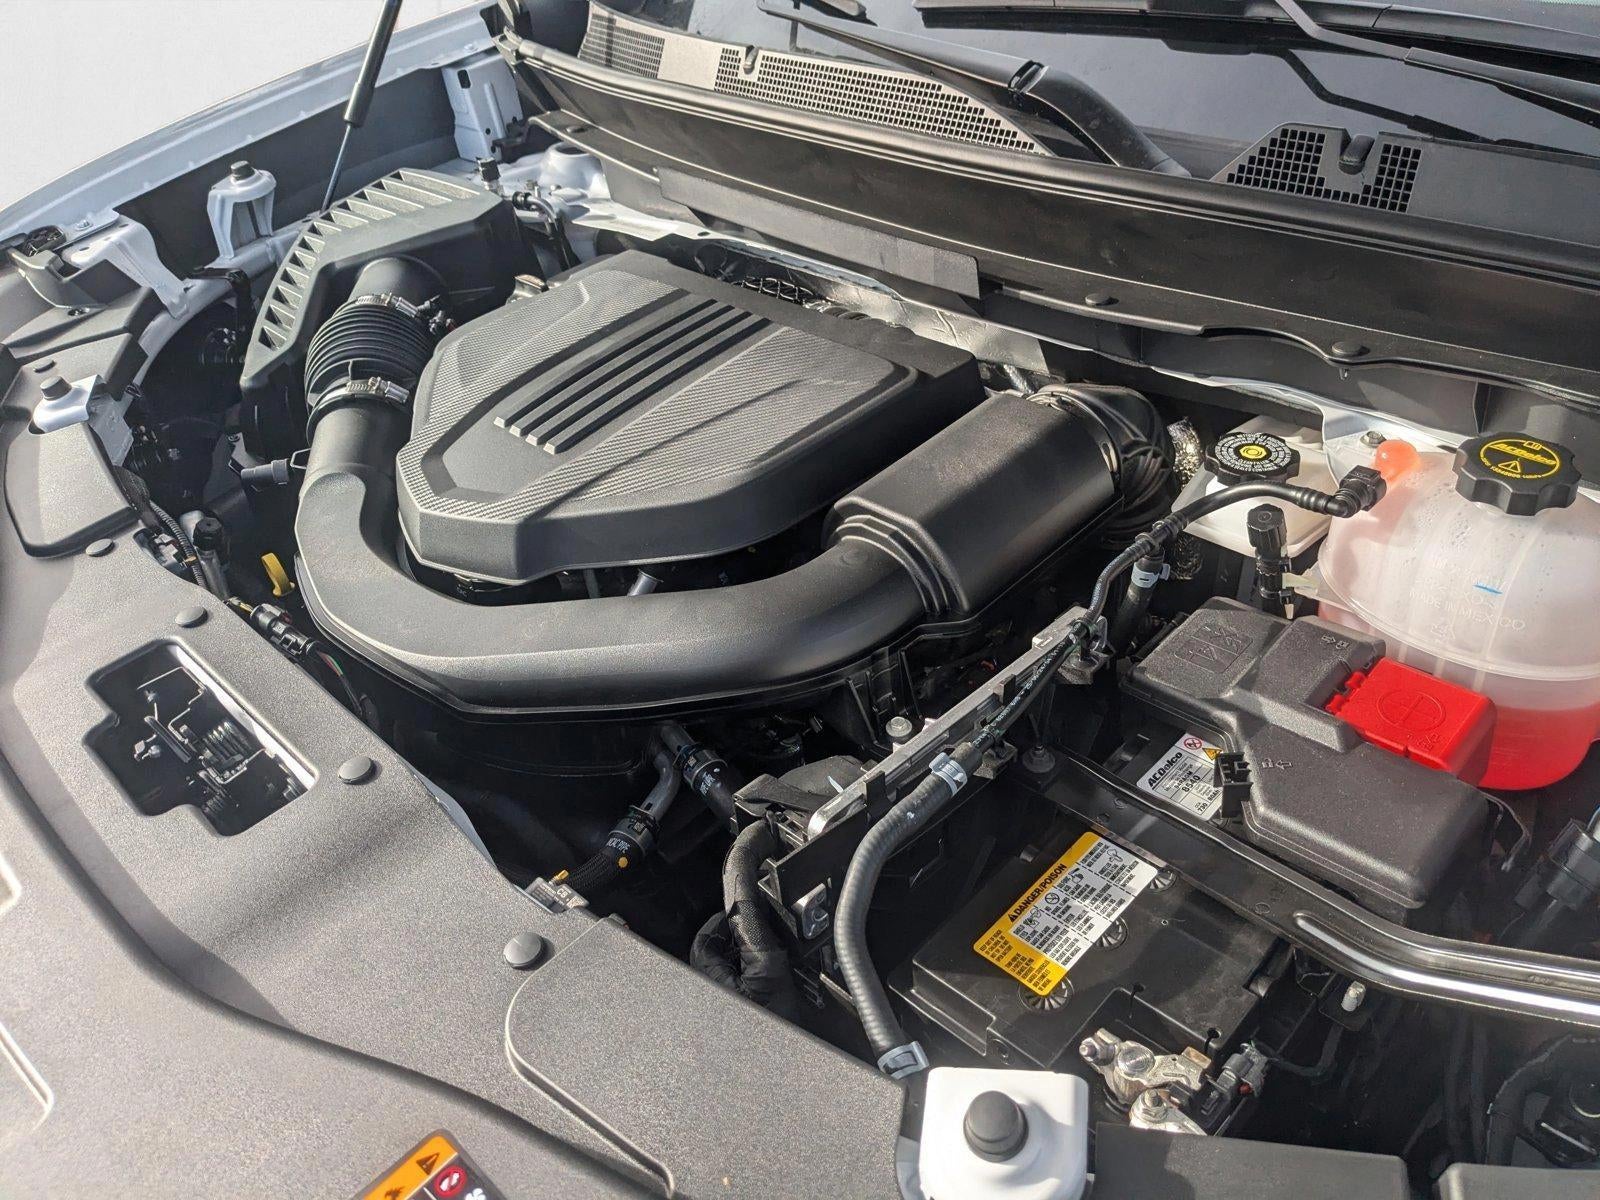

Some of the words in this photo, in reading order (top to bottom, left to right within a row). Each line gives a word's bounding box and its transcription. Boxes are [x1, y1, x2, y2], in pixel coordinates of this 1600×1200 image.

[1459, 601, 1525, 631] MEXICO
[1147, 752, 1183, 788] ACDelco
[1181, 774, 1201, 792] 8540
[1014, 863, 1066, 916] DANGER/POISON
